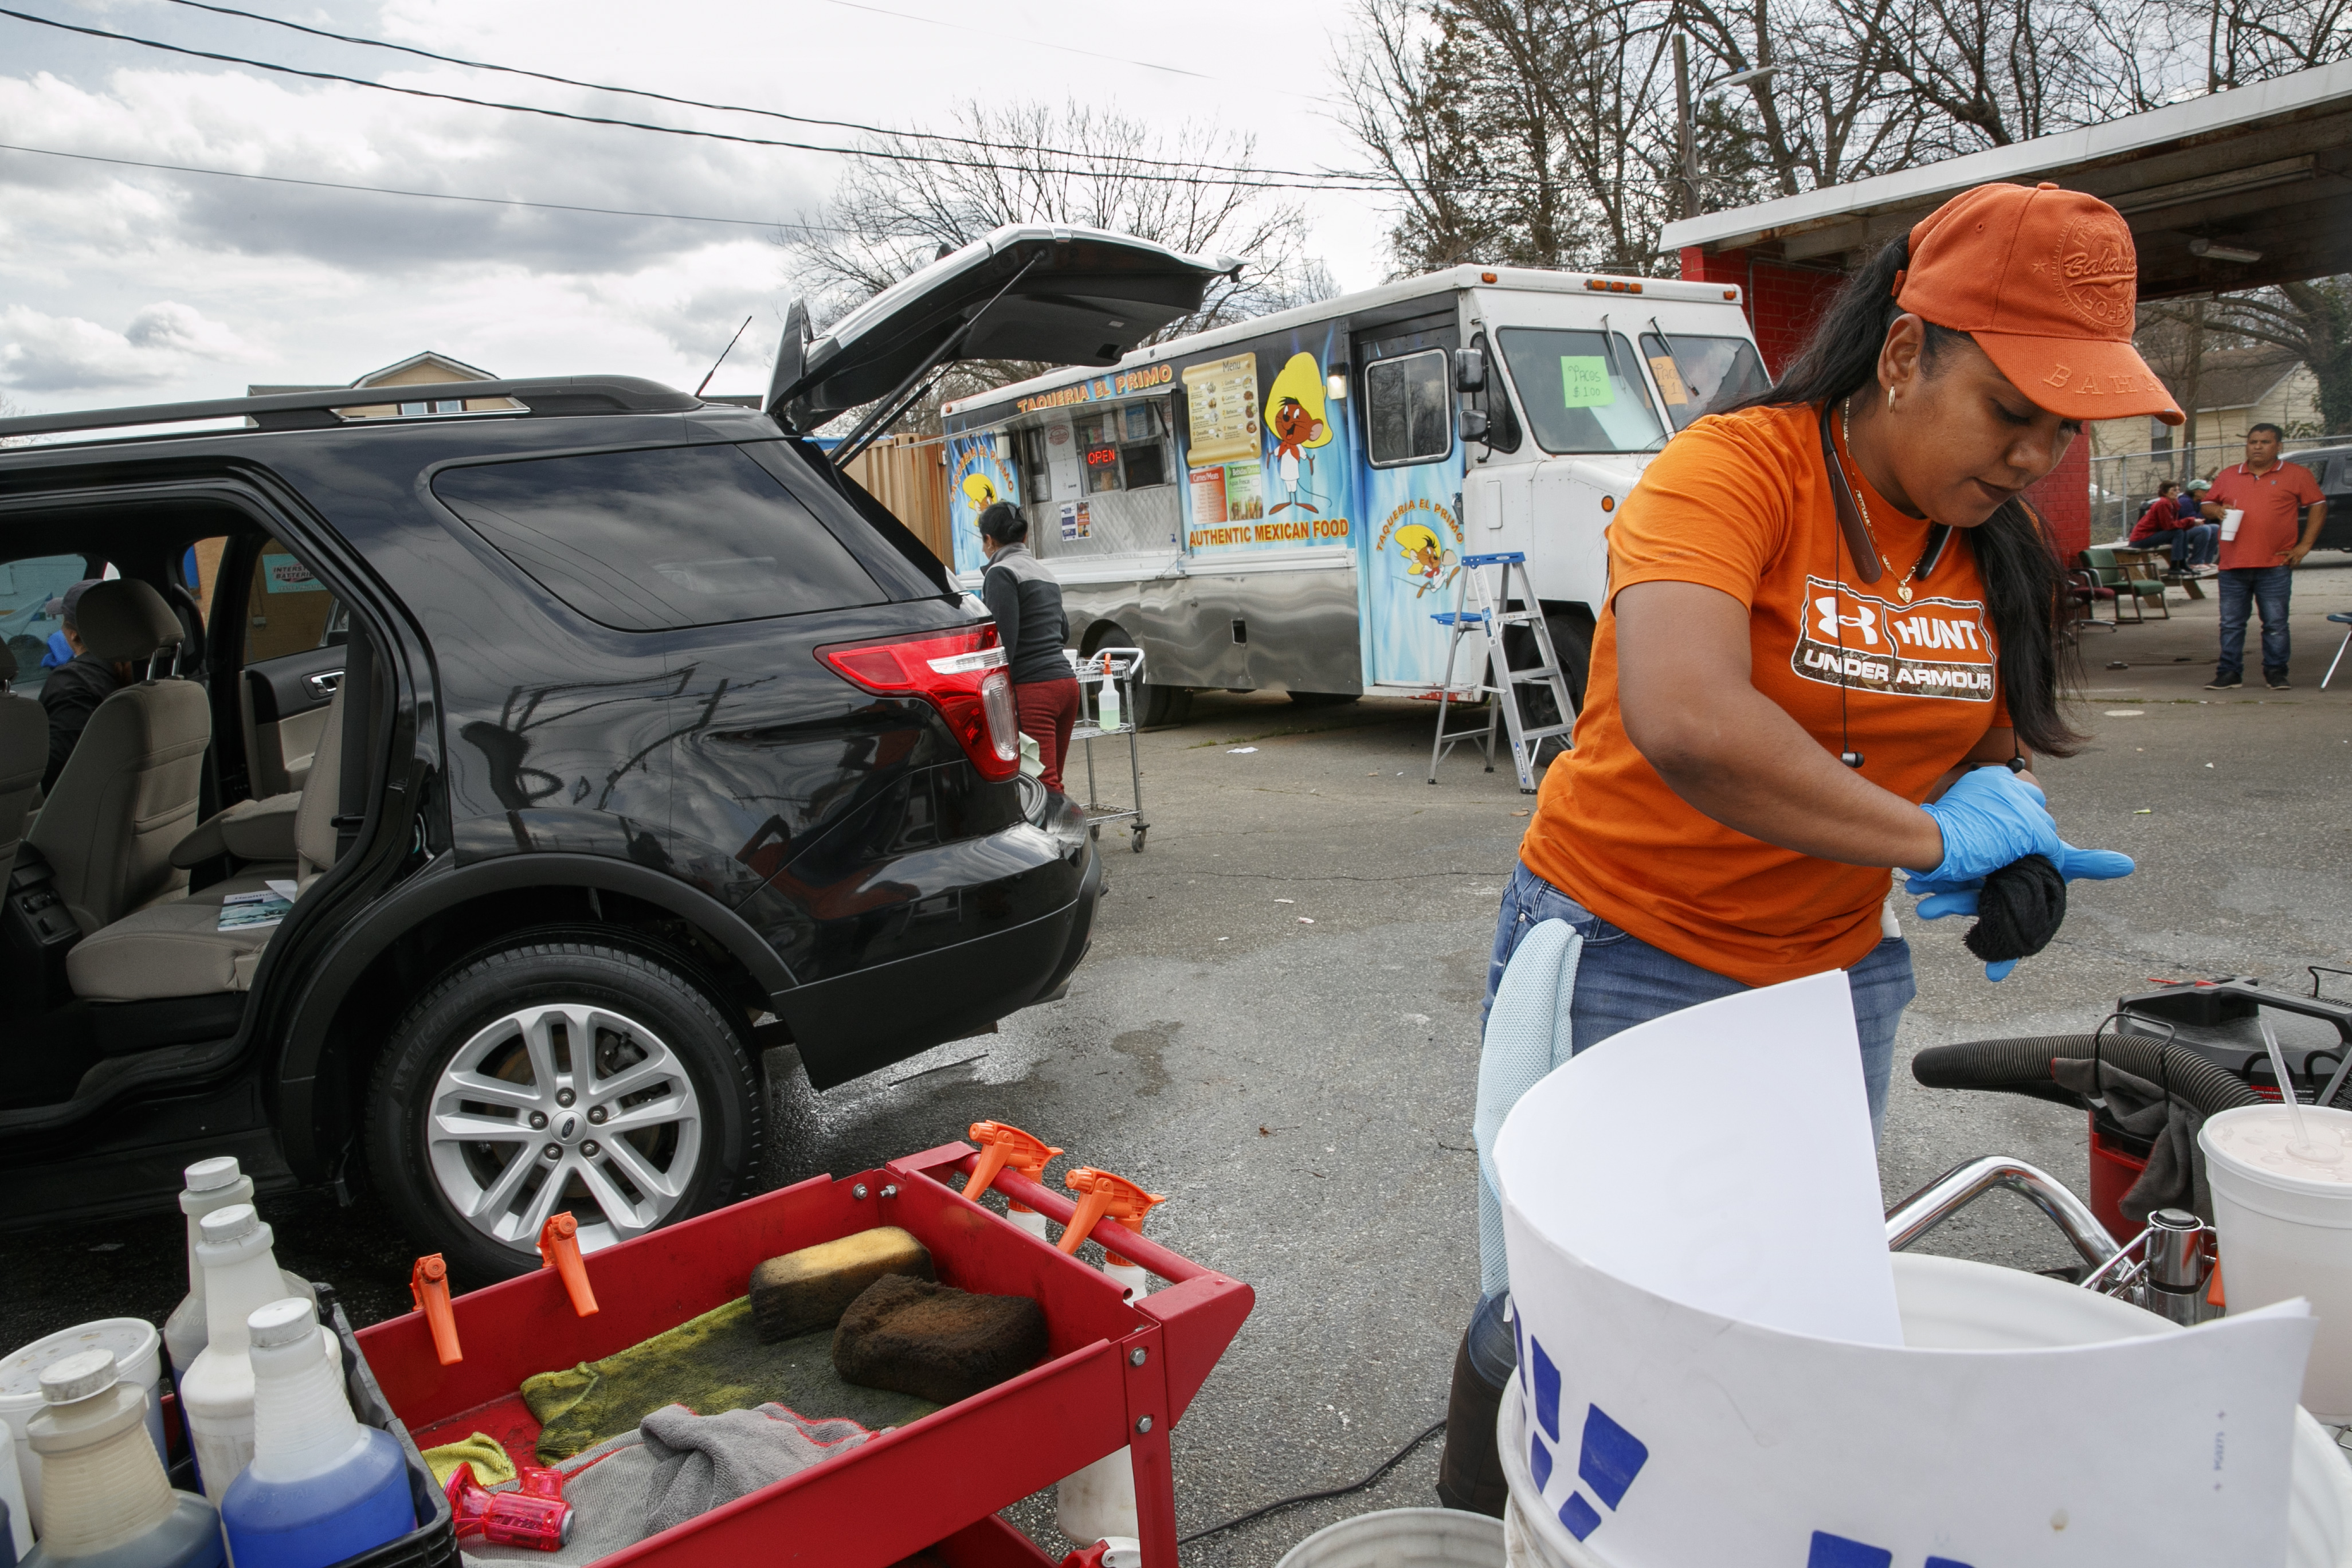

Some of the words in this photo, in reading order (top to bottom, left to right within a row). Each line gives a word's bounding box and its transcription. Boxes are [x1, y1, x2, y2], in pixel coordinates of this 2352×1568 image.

[1222, 360, 1241, 373] Menu
[1017, 385, 1089, 413] TAQUERIA
[1093, 381, 1111, 398] EL
[1115, 364, 1173, 394] PRIMO
[1088, 449, 1115, 465] OPEN
[951, 446, 977, 503] TAQUERIA
[979, 445, 987, 458] EL
[990, 450, 1014, 493] PRIMO
[1193, 472, 1219, 482] Carnes/Meats
[1189, 526, 1251, 547] AUTHENTIC
[1255, 522, 1309, 542] MEXICAN
[1312, 519, 1349, 539] FOOD
[1376, 500, 1416, 552] TAQUERIA
[1419, 499, 1430, 511] EL
[1434, 503, 1464, 544] PRIMO
[1861, 554, 1871, 574] ANKER
[1893, 617, 1978, 650] HUNT
[1804, 649, 1890, 682] UNDER
[1896, 668, 1992, 690] ARMOUR
[1516, 750, 1526, 775] WERNER
